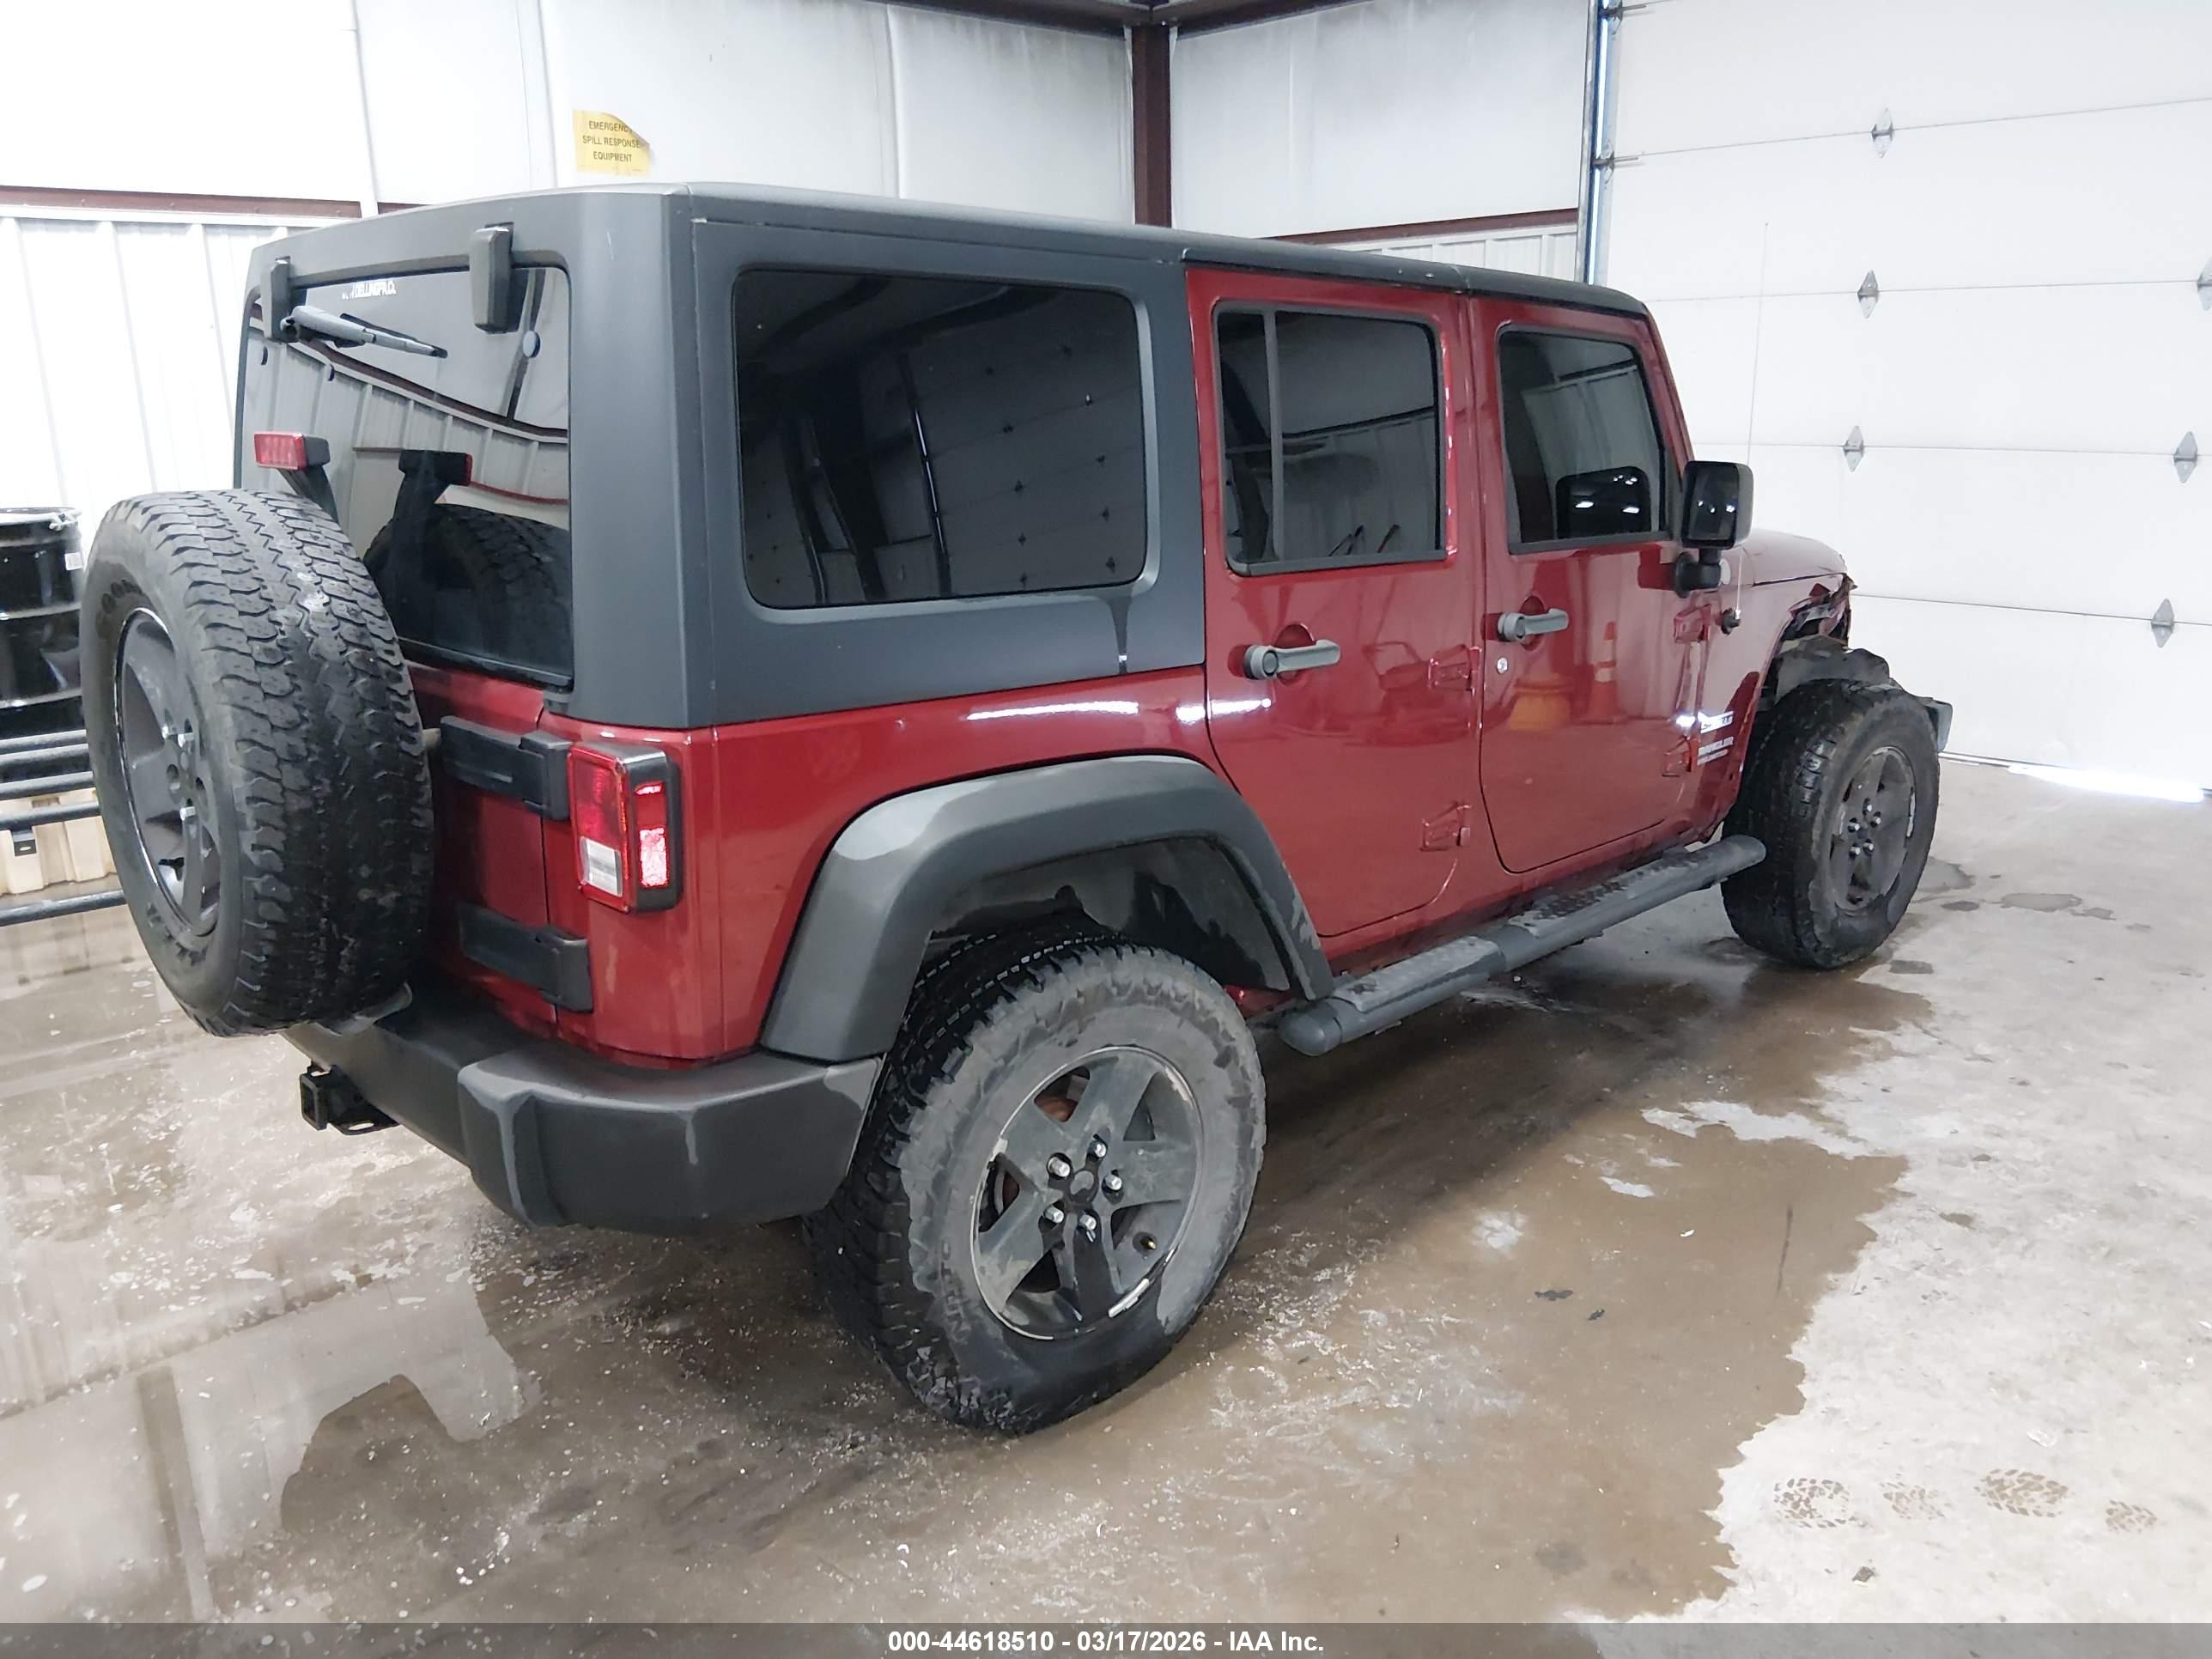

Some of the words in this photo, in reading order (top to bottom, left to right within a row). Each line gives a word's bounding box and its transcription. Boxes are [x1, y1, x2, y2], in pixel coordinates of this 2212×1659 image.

[582, 135, 602, 144] SPILL
[604, 137, 641, 149] RESPONSE
[593, 151, 632, 162] EQUIPMENT
